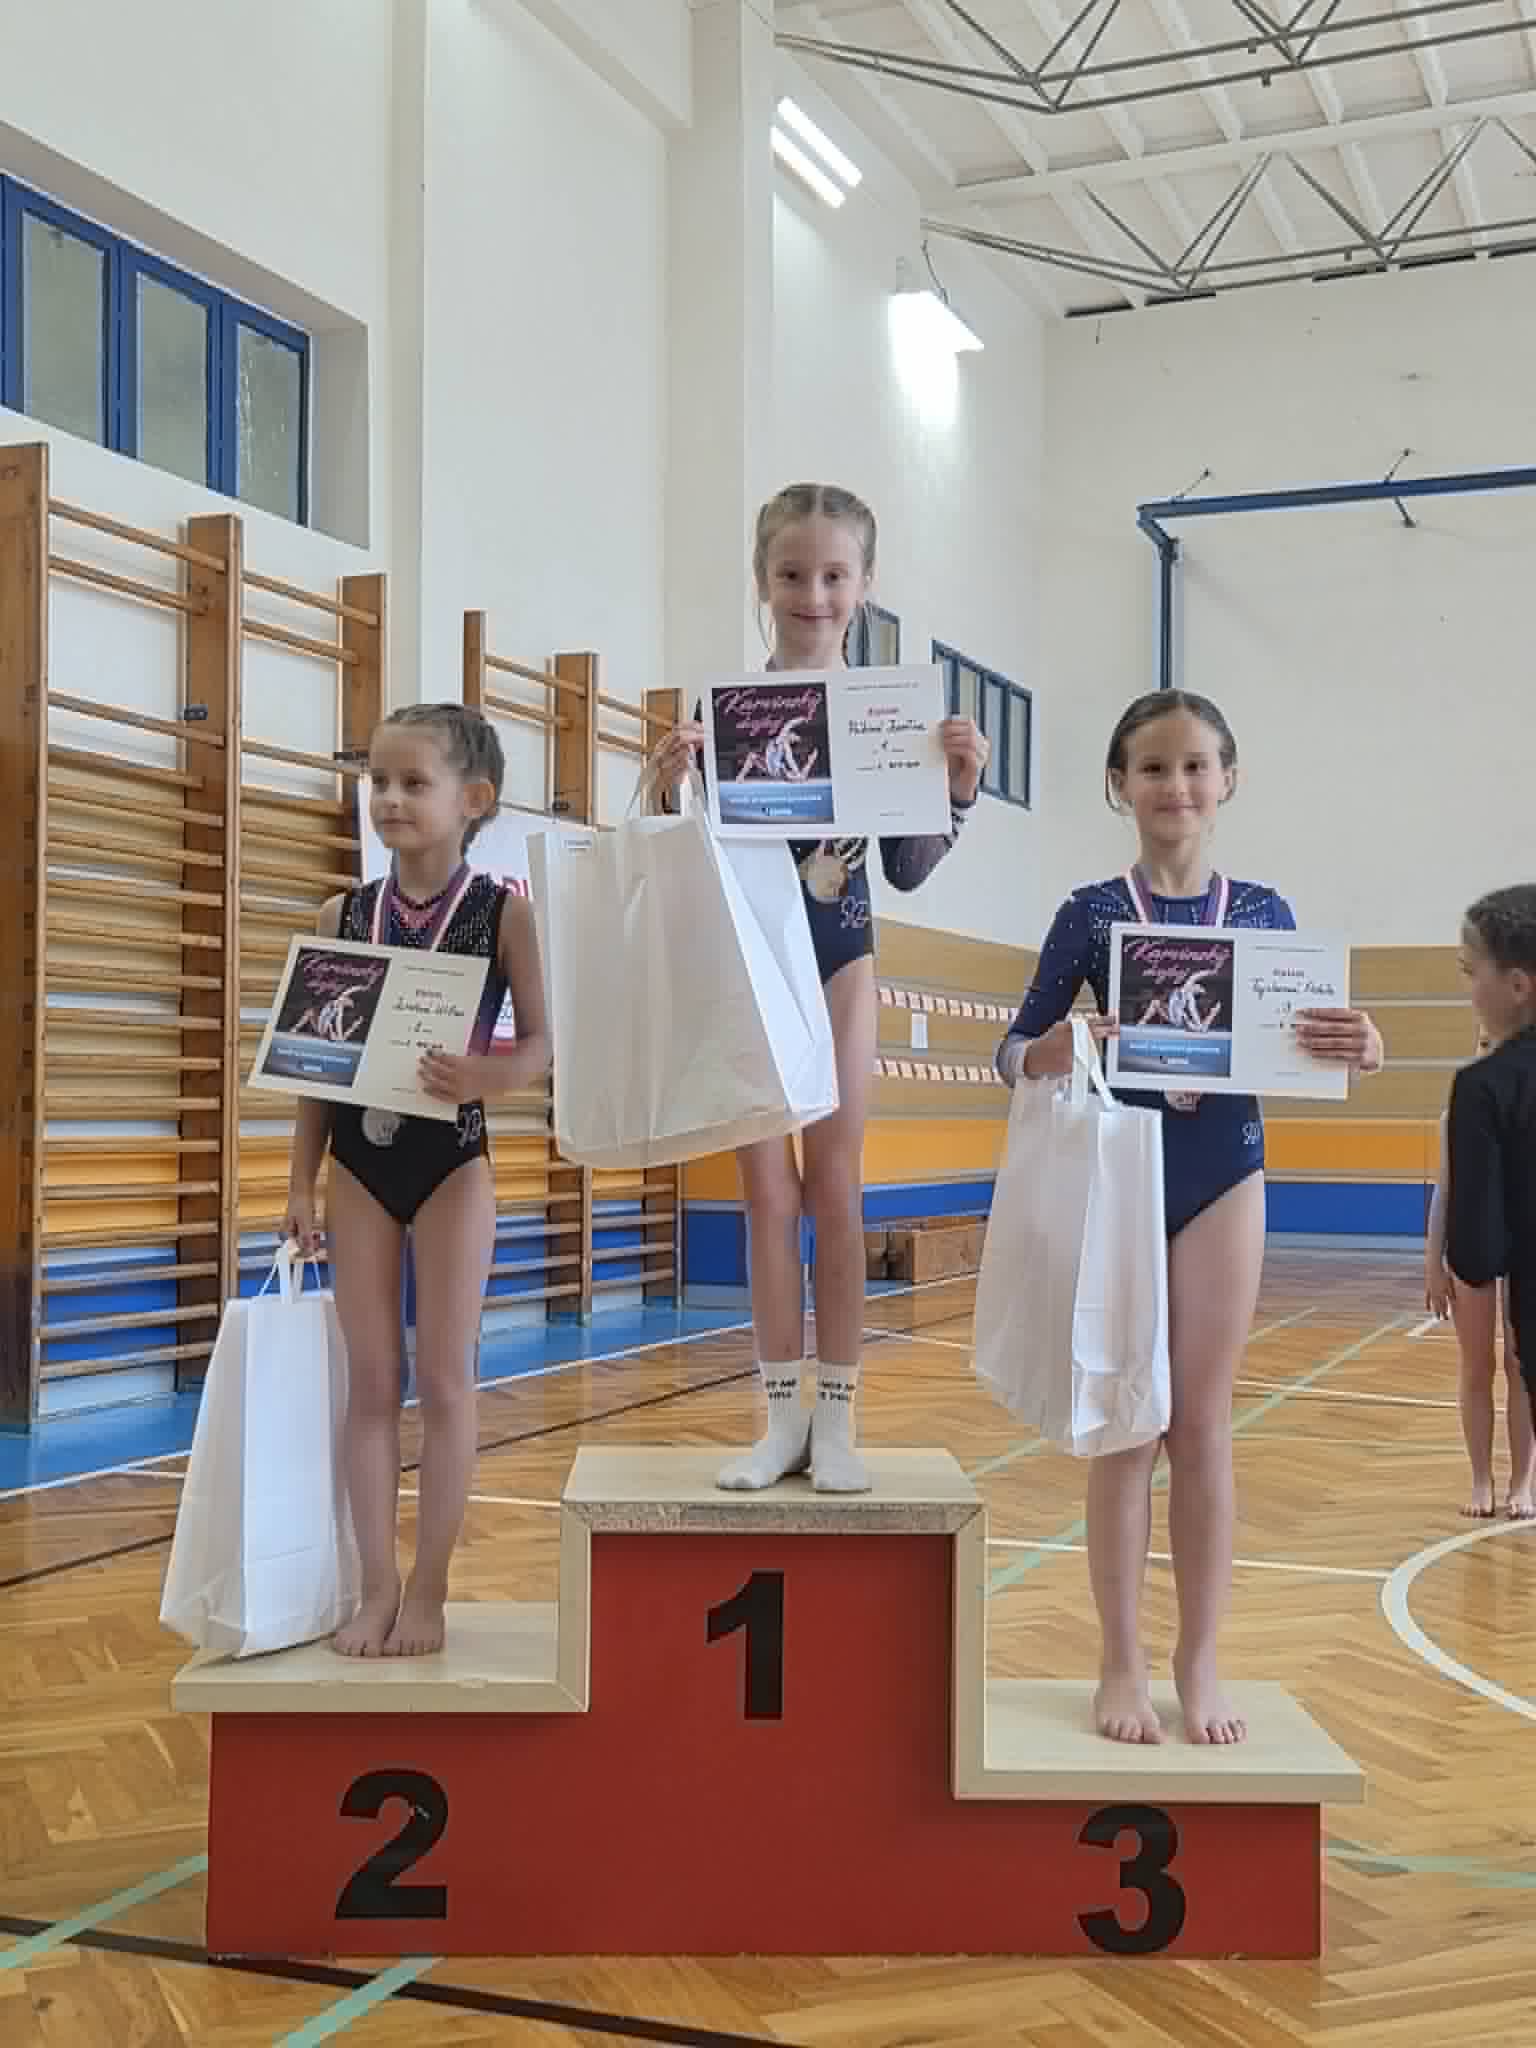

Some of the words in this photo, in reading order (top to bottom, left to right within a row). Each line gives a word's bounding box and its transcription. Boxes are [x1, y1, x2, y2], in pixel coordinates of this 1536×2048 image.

[706, 1570, 784, 1720] 1
[336, 1769, 448, 1919] 2
[1077, 1804, 1187, 1955] 3
